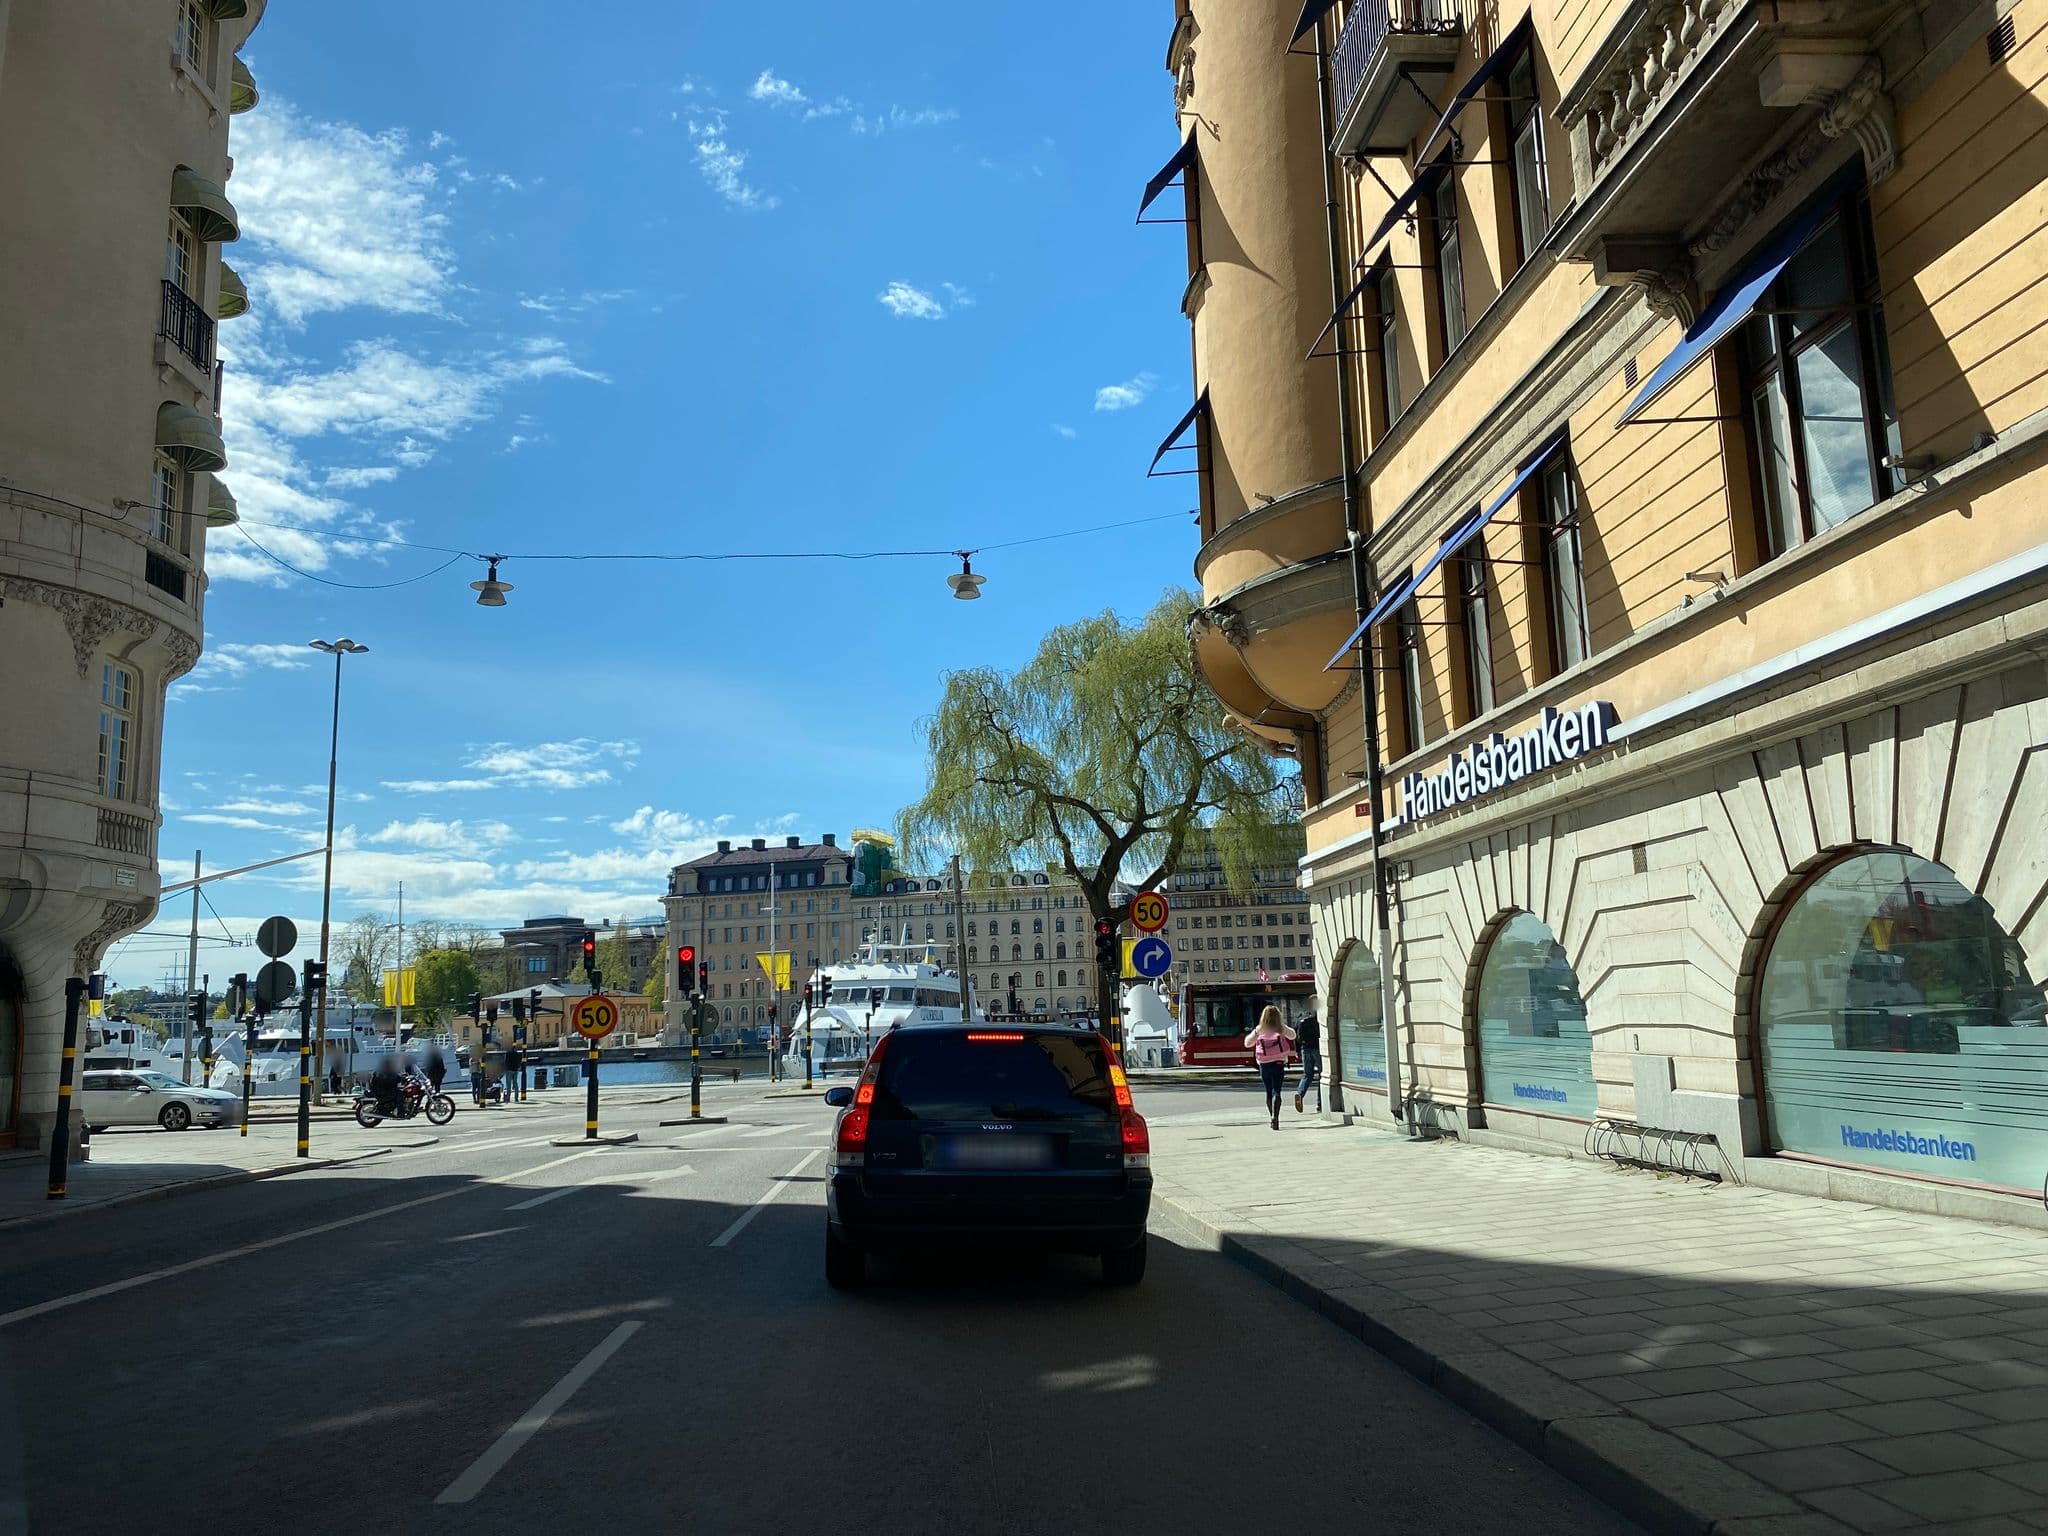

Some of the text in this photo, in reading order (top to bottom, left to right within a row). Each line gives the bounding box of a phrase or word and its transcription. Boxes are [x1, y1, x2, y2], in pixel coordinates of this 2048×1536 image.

[1401, 700, 1604, 823] Handelsbanken
[1137, 902, 1163, 922] 50
[581, 1005, 611, 1028] 50
[1512, 1082, 1568, 1103] Handelsbanken
[1840, 1124, 1977, 1161] Handelsbanken
